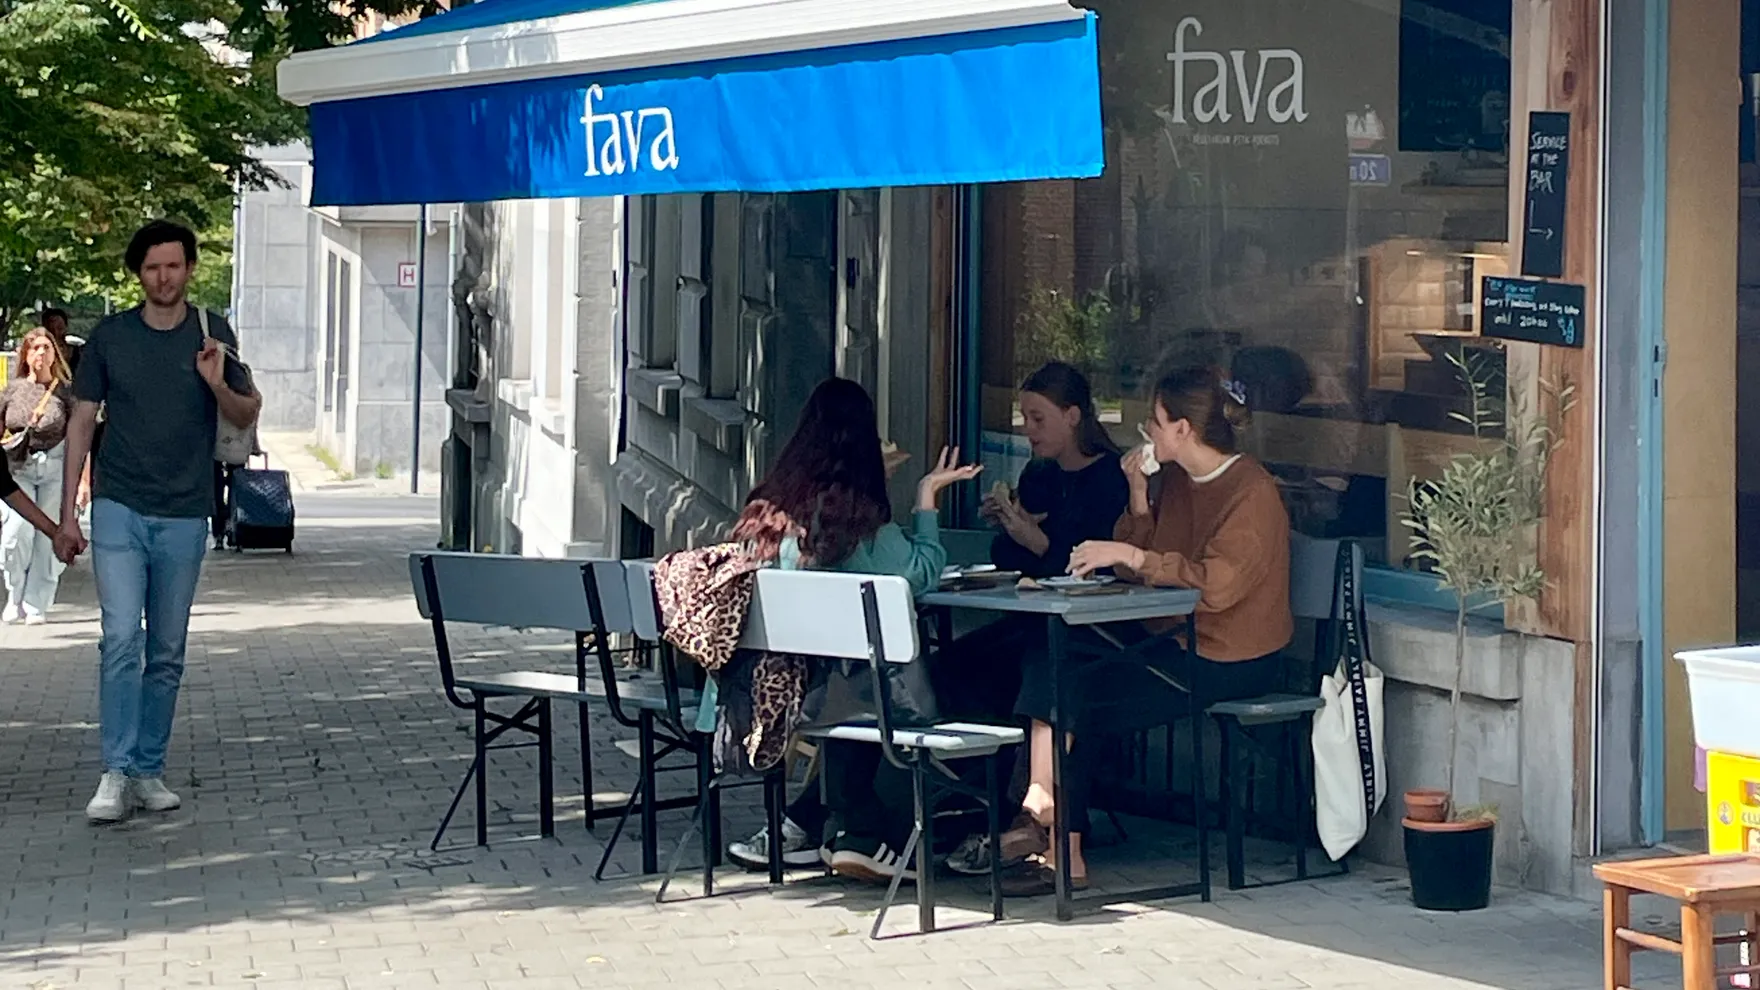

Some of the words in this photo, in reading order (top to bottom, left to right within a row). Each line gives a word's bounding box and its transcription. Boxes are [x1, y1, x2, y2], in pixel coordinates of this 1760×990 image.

[1166, 16, 1310, 123] fava
[579, 83, 680, 176] fava
[1530, 131, 1567, 150] SERVICE
[1529, 170, 1554, 193] BAR
[403, 267, 415, 283] H
[1357, 709, 1370, 753] JIMMY
